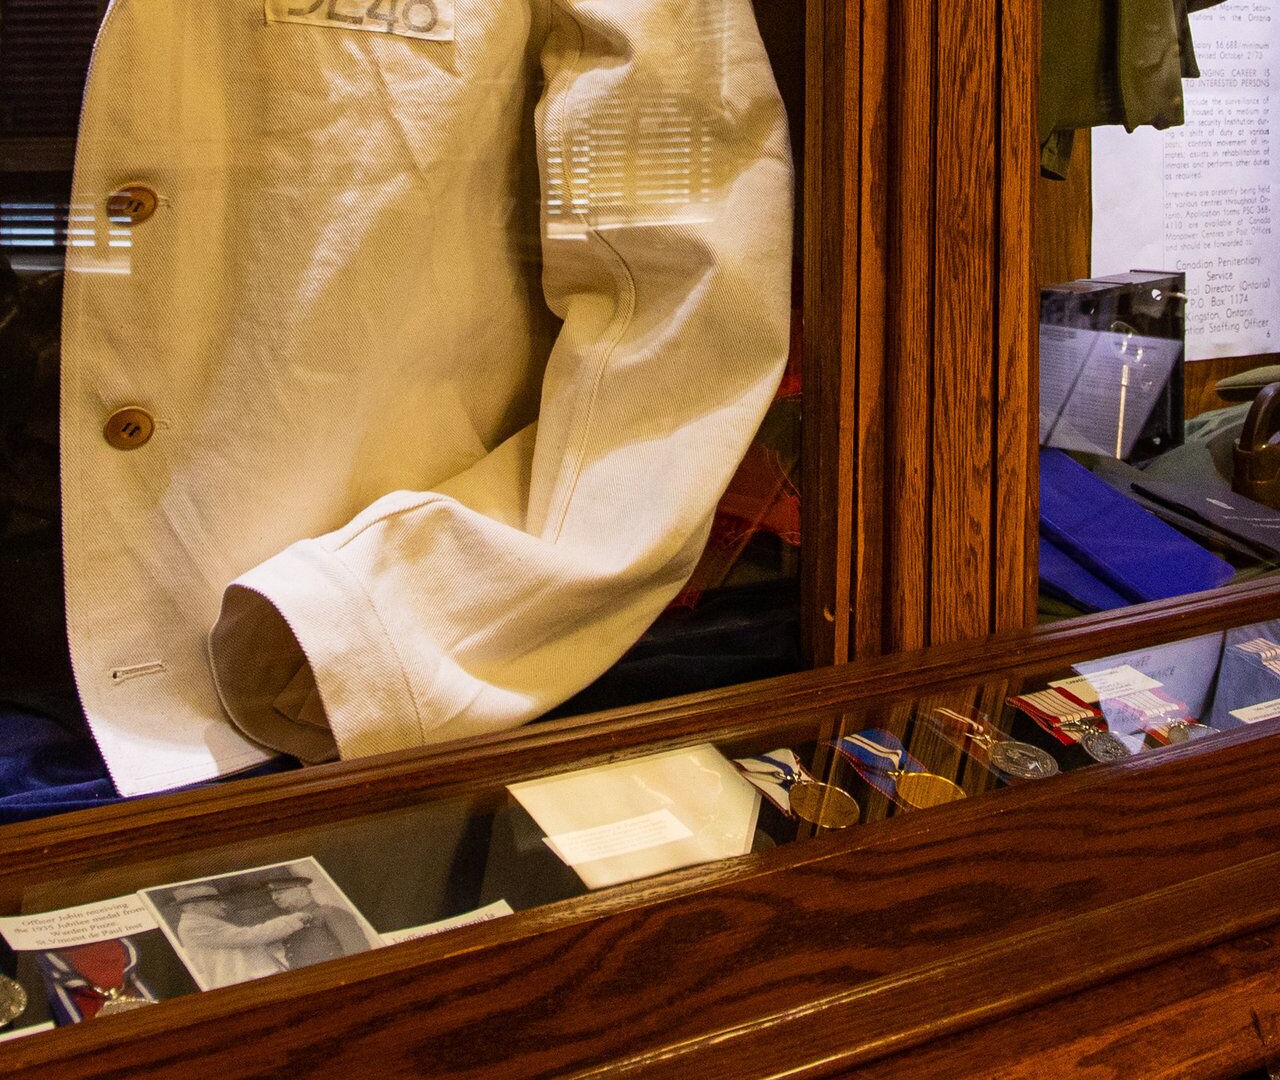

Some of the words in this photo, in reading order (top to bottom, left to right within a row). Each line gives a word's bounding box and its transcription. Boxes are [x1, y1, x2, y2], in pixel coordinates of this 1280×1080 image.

[1231, 68, 1257, 78] CAREER
[1264, 68, 1271, 78] IS
[1185, 79, 1195, 88] TO
[1198, 79, 1238, 88] INTERESTED
[1241, 79, 1270, 88] PERSONS
[1176, 260, 1214, 271] Canadian
[1218, 256, 1261, 267] Penitentiary
[1207, 271, 1233, 282] Service
[1205, 284, 1235, 295] Director
[1240, 278, 1271, 292] (Ontario)
[1211, 296, 1225, 308] Box
[1230, 294, 1249, 306] 1174
[1226, 308, 1254, 319] Ontario
[1185, 326, 1205, 335] ntion
[1208, 322, 1240, 334] Staffing
[1243, 318, 1269, 330] Officer
